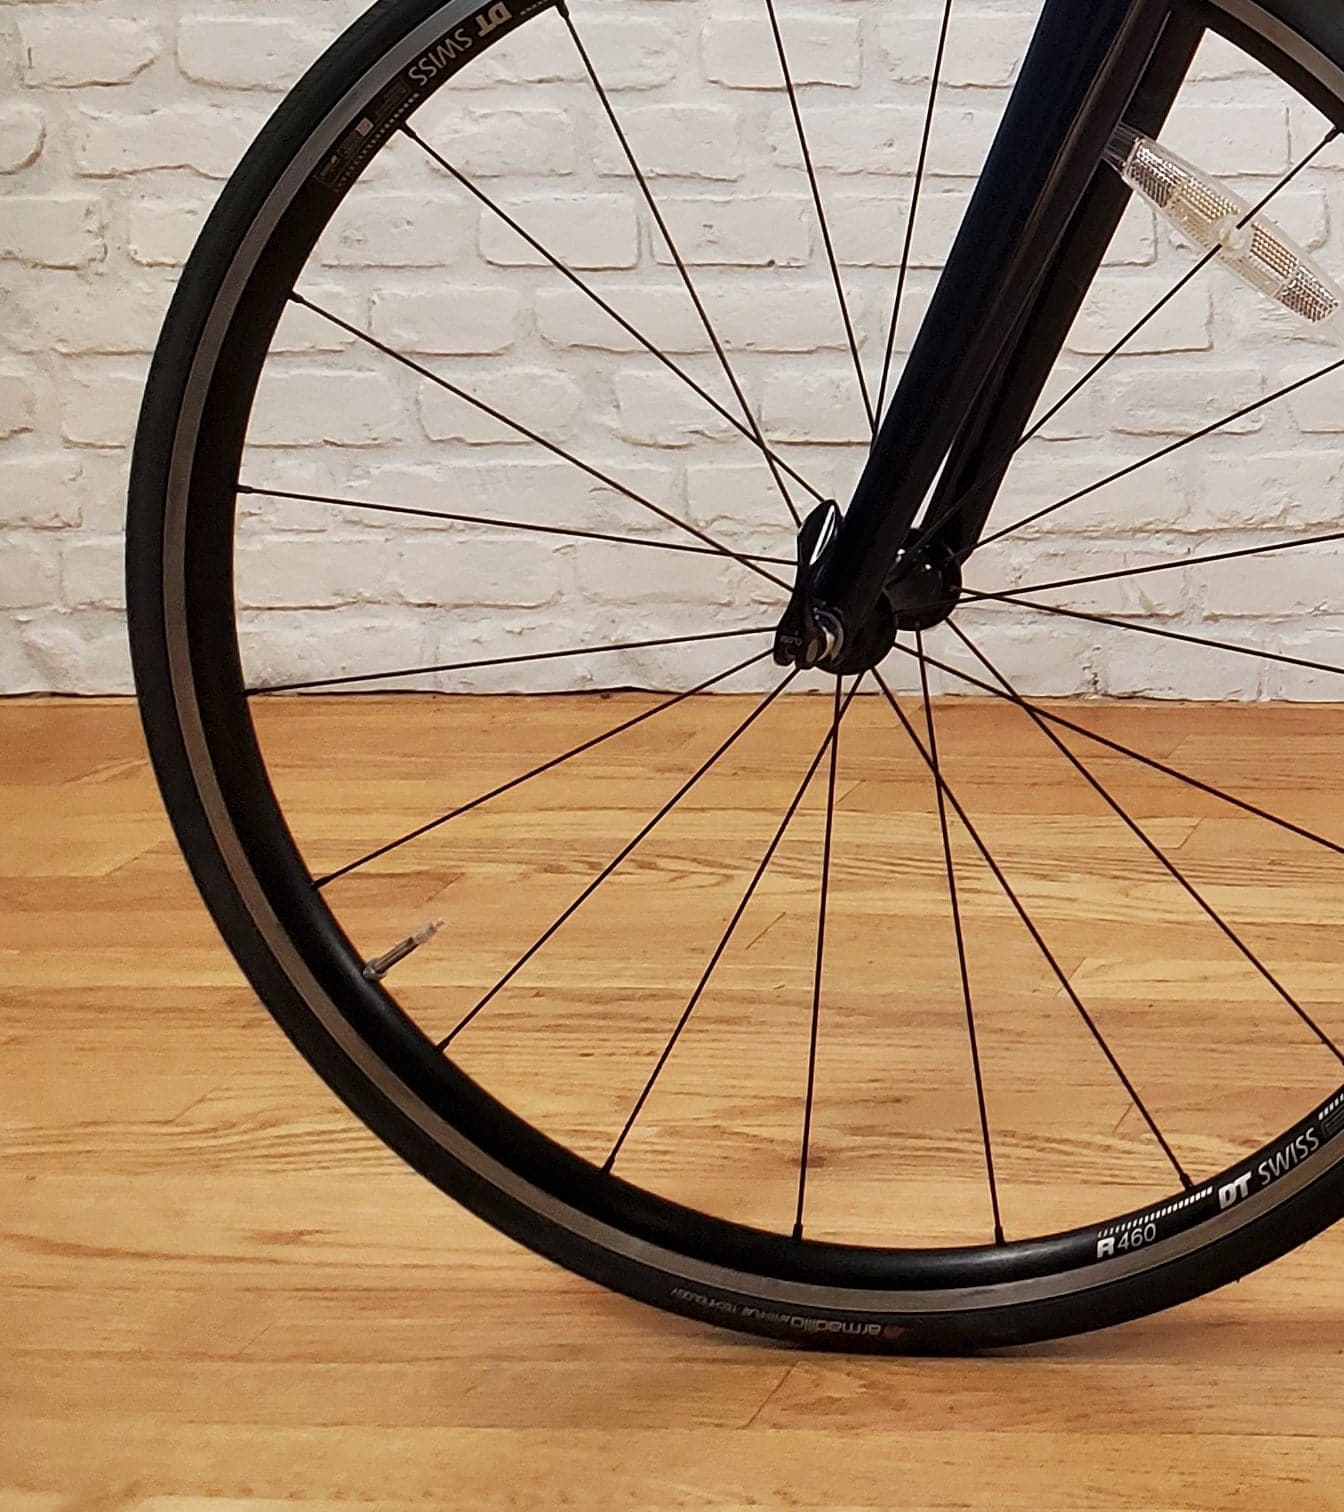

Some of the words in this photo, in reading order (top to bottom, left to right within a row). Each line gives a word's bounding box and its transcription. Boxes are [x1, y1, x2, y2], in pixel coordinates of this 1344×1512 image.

[475, 1, 512, 37] DT
[409, 28, 473, 86] SWISS
[1218, 1171, 1252, 1209] DT
[1257, 1127, 1320, 1186] SWISS
